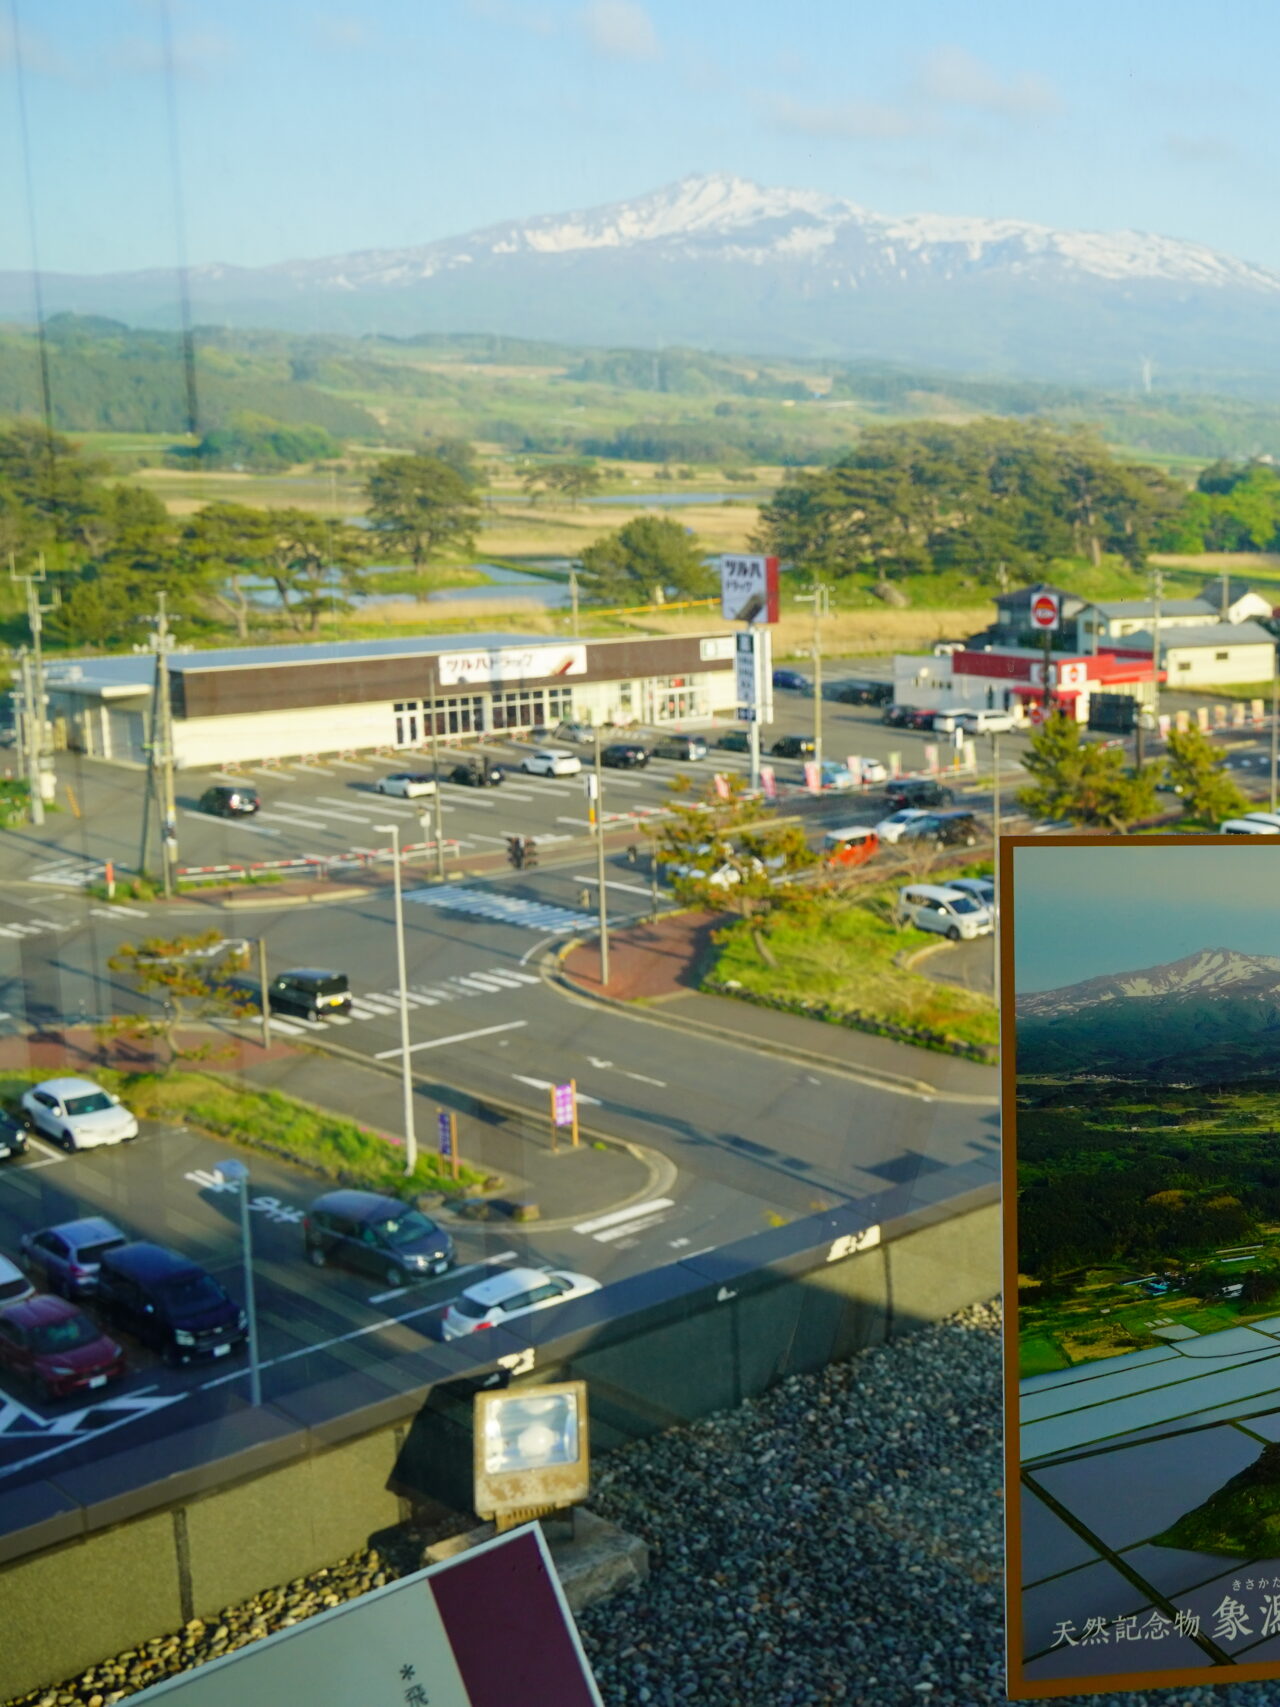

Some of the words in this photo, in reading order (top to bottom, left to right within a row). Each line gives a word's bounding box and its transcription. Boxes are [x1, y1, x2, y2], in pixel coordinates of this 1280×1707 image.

[725, 560, 762, 578] ツルハ
[1050, 1608, 1201, 1648] 天然記念物
